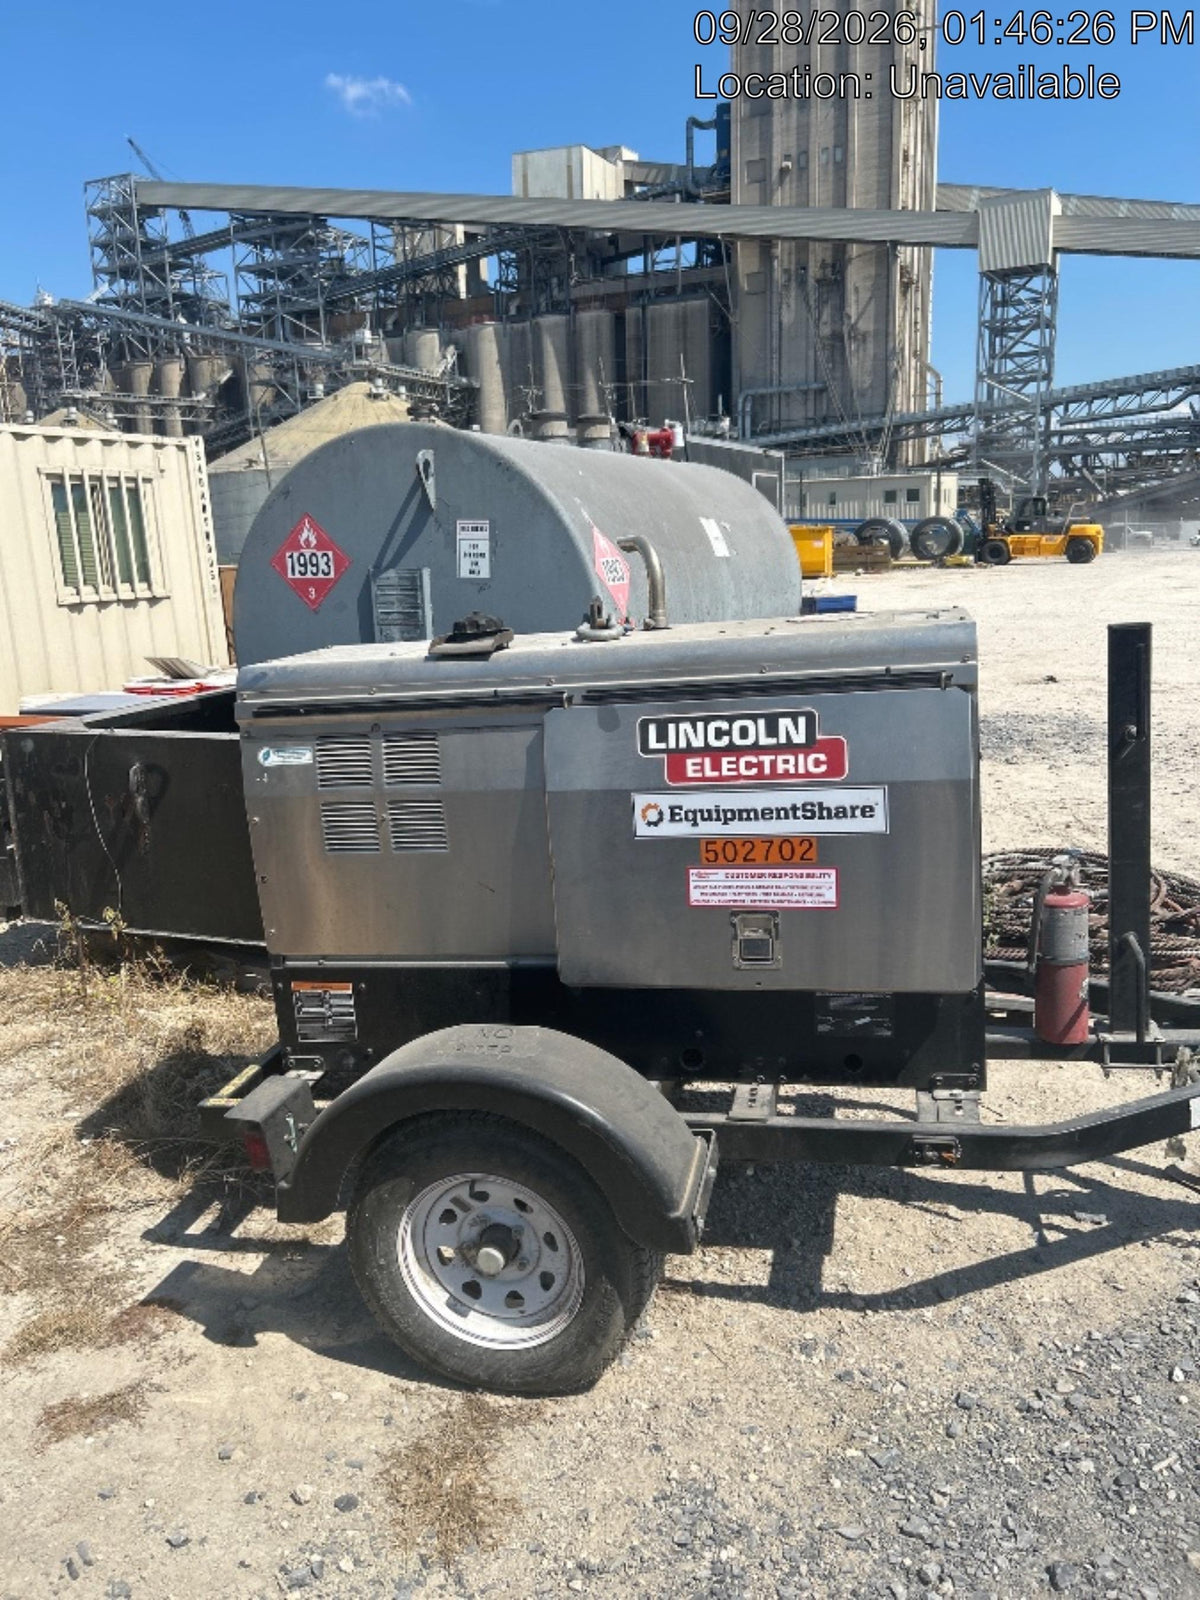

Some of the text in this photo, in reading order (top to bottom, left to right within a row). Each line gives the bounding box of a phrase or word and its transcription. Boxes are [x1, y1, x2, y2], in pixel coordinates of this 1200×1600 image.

[287, 552, 332, 577] 1993
[308, 586, 316, 600] 3
[648, 715, 807, 750] LINCOLN
[685, 752, 828, 778] ELECTRIC
[668, 801, 877, 827] EquipmentShare
[704, 838, 814, 863] 502702
